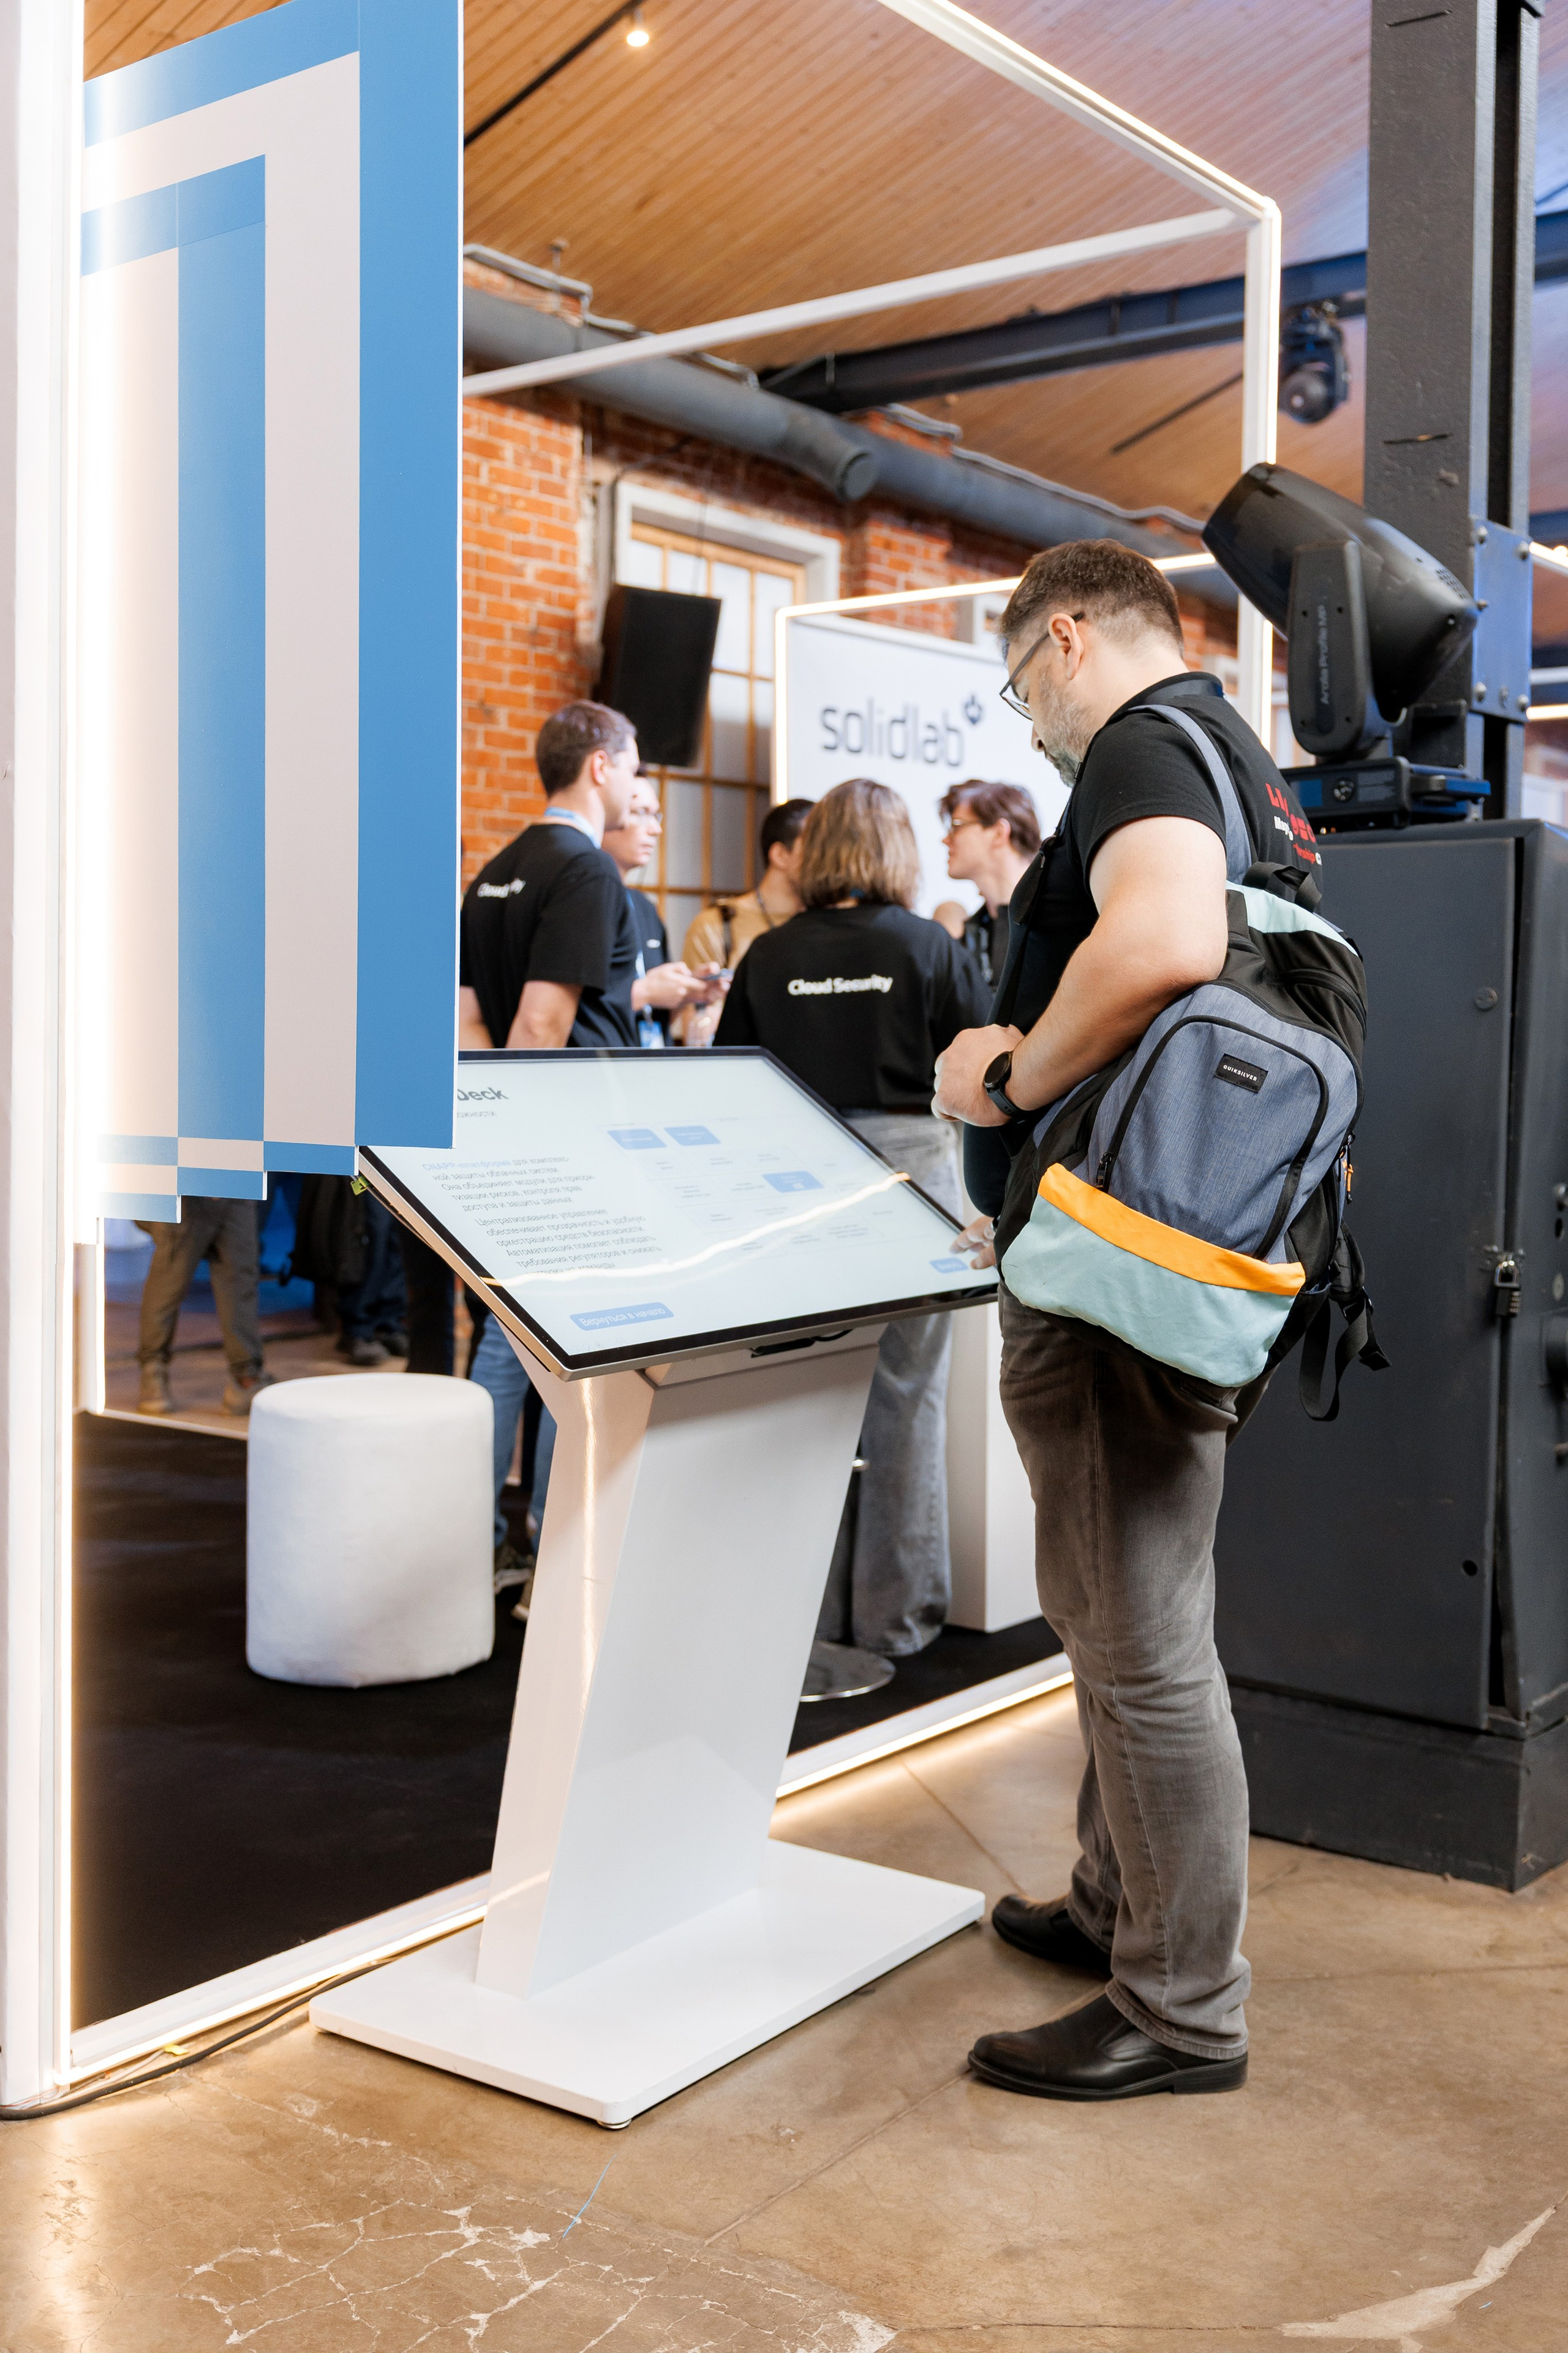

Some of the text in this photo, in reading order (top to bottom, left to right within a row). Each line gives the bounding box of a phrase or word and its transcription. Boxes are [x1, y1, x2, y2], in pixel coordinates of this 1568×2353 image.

[821, 700, 963, 766] solidlab
[788, 974, 893, 995] Cloud Security
[1223, 1065, 1257, 1081] QUIKSILVER
[462, 1180, 513, 1189] объединяет
[462, 1203, 499, 1211] доступа
[475, 1209, 608, 1226] Централизованное управление
[487, 1225, 546, 1236] обеспечивает
[547, 1220, 604, 1231] прозрачность
[611, 1215, 646, 1225] удобную
[497, 1236, 554, 1247] оркестрацию
[554, 1232, 589, 1242] средств
[507, 1235, 657, 1256] Автоматизация помогает соблюдать
[516, 1256, 568, 1268] требования
[568, 1250, 620, 1263] регуляторов
[628, 1245, 662, 1255] снижать
[579, 1314, 627, 1326] Вернуться
[635, 1307, 666, 1318] начало
